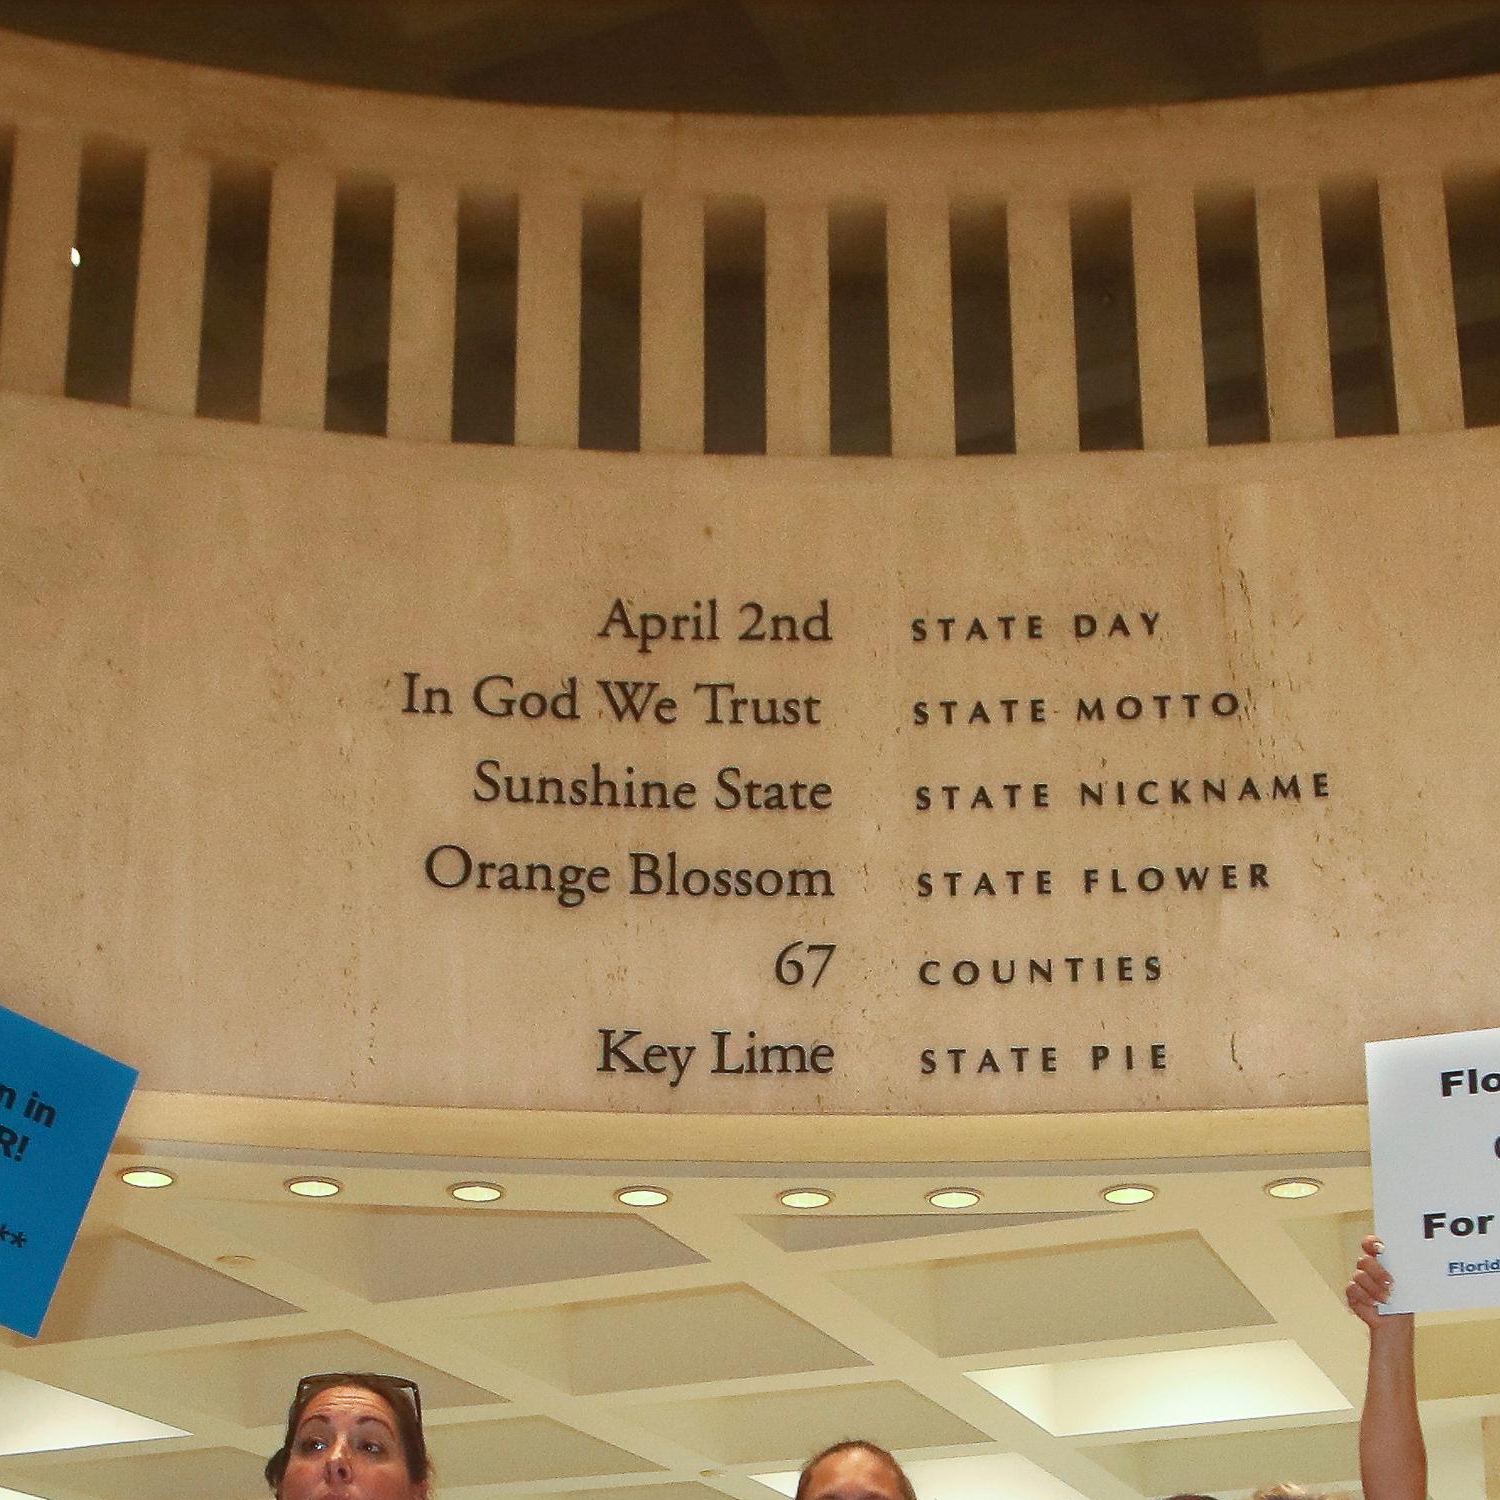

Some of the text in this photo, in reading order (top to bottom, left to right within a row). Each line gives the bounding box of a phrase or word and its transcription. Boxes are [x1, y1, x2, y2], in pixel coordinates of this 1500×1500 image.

[597, 599, 832, 652] April 2nd
[911, 611, 1162, 643] STATE DAY
[402, 672, 821, 727] In God We Trust
[912, 691, 1240, 727] STATE MOTTO
[473, 759, 833, 812] Sunshine State
[916, 770, 1332, 811] STATE NICKNAME
[424, 844, 836, 907] Orange Blossom
[917, 861, 1272, 898] STATE FLOWER
[774, 941, 837, 988] 67
[918, 955, 1163, 987] COUNTIES
[597, 1028, 836, 1086] Key Lime
[920, 1041, 1169, 1075] STATE PIE
[23, 1090, 57, 1128] in
[1423, 1211, 1495, 1240] For
